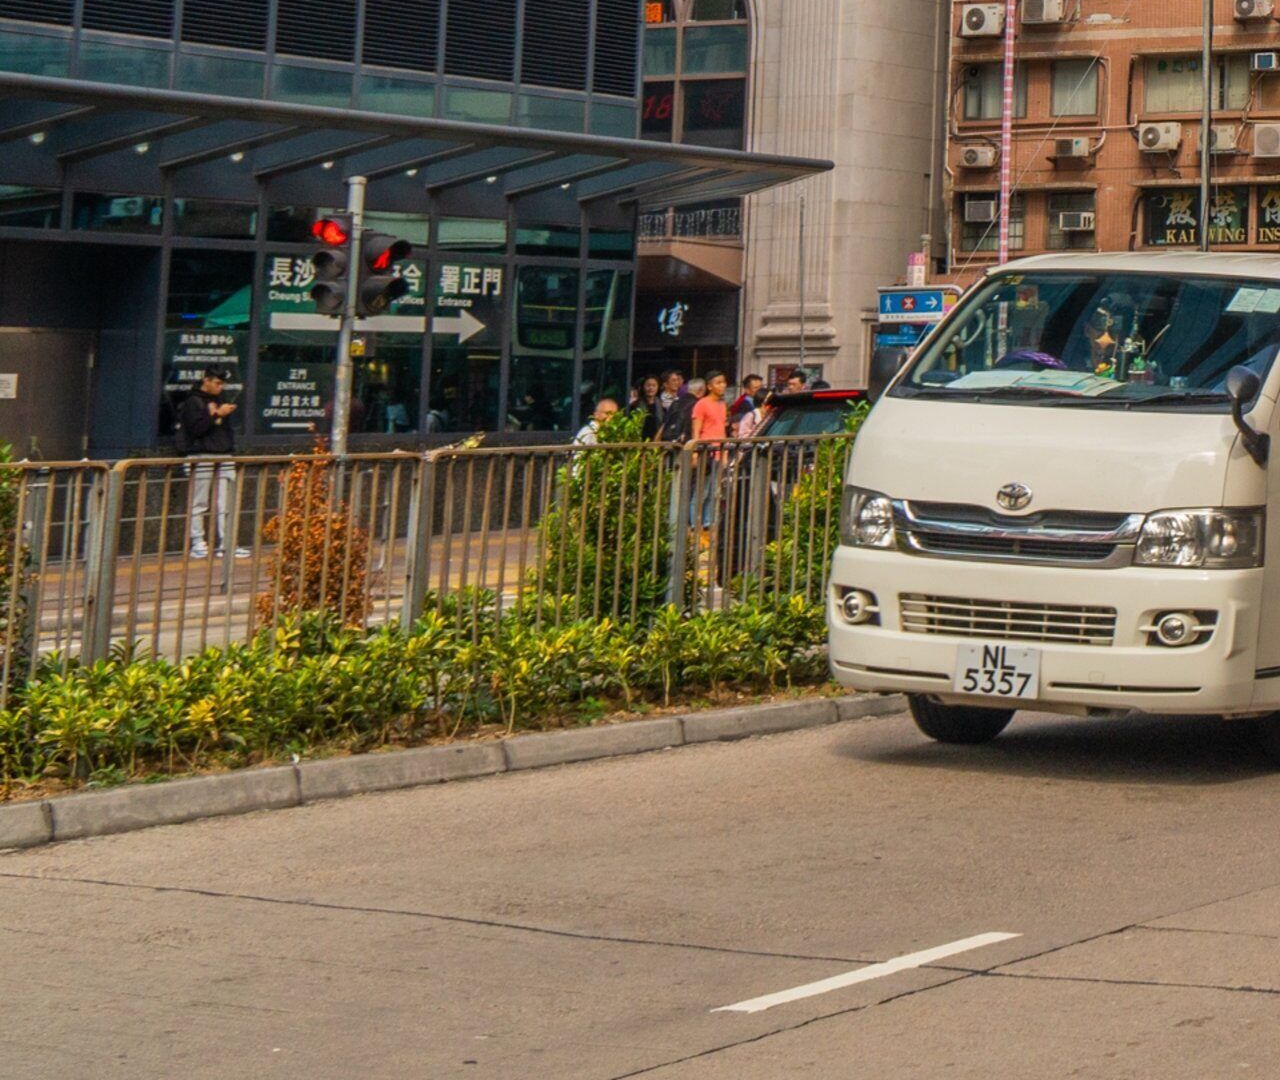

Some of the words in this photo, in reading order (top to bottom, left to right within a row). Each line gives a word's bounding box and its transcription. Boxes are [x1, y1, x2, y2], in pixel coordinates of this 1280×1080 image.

[1166, 229, 1196, 244] KAI
[438, 297, 473, 308] Entrance
[289, 369, 307, 380] 正門
[277, 381, 316, 391] ENTRANCE
[263, 408, 290, 417] OFFICE
[292, 408, 325, 417] BUILDING
[982, 645, 1016, 670] NL
[963, 668, 1032, 696] 5357
